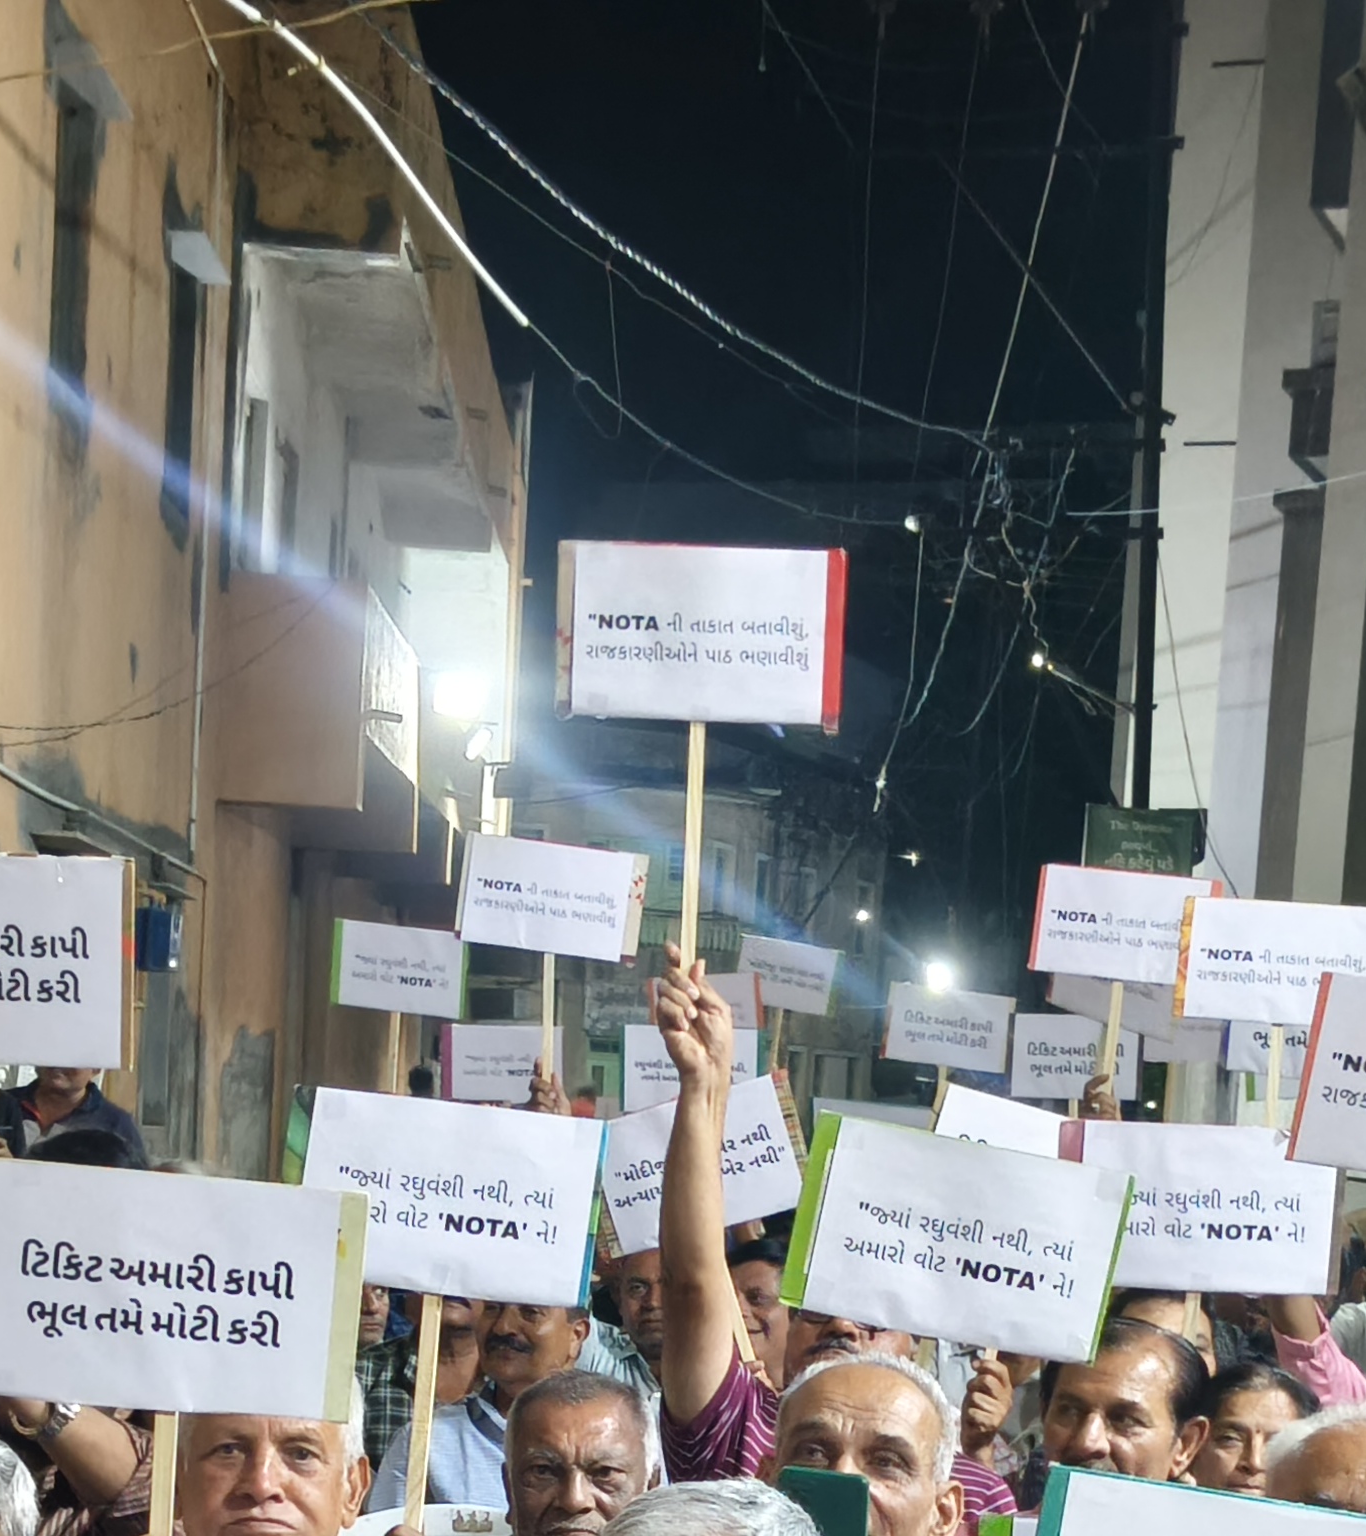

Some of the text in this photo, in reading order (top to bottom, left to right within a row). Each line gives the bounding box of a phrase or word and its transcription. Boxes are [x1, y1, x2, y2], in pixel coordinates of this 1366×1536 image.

[588, 613, 660, 632] "NOTA
[667, 612, 682, 632] ની
[690, 620, 734, 634] તાકાત
[586, 641, 697, 663] રાજકારણીઓને
[705, 649, 732, 664] પાઠ
[1051, 909, 1097, 925] "NOTA
[30, 926, 89, 959] કાપી
[37, 969, 81, 1004] કરી
[339, 1165, 553, 1209] "જ્યાં રઘુવંશી નથી, ત્યાં
[1165, 1188, 1221, 1214] રઘુવંશી
[1229, 1190, 1265, 1213] નથી,
[1274, 1197, 1300, 1212] ત્યાં
[397, 1204, 428, 1229] વોટ
[438, 1212, 527, 1240] 'NOTA'
[536, 1220, 557, 1244] ને!
[859, 1201, 1072, 1262] "જ્યાં રઘુવંશી નથી, ત્યાં
[1164, 1217, 1192, 1238] વોટ
[1201, 1223, 1279, 1241] 'NOTA'
[1287, 1223, 1305, 1242] ને!
[21, 1238, 294, 1300] ટિકિટ અમારી કાપી
[844, 1237, 1074, 1298] અમારો વોટ 'NOTA' ને!
[27, 1298, 280, 1348] ભૂલ તમે મોટી કરી
